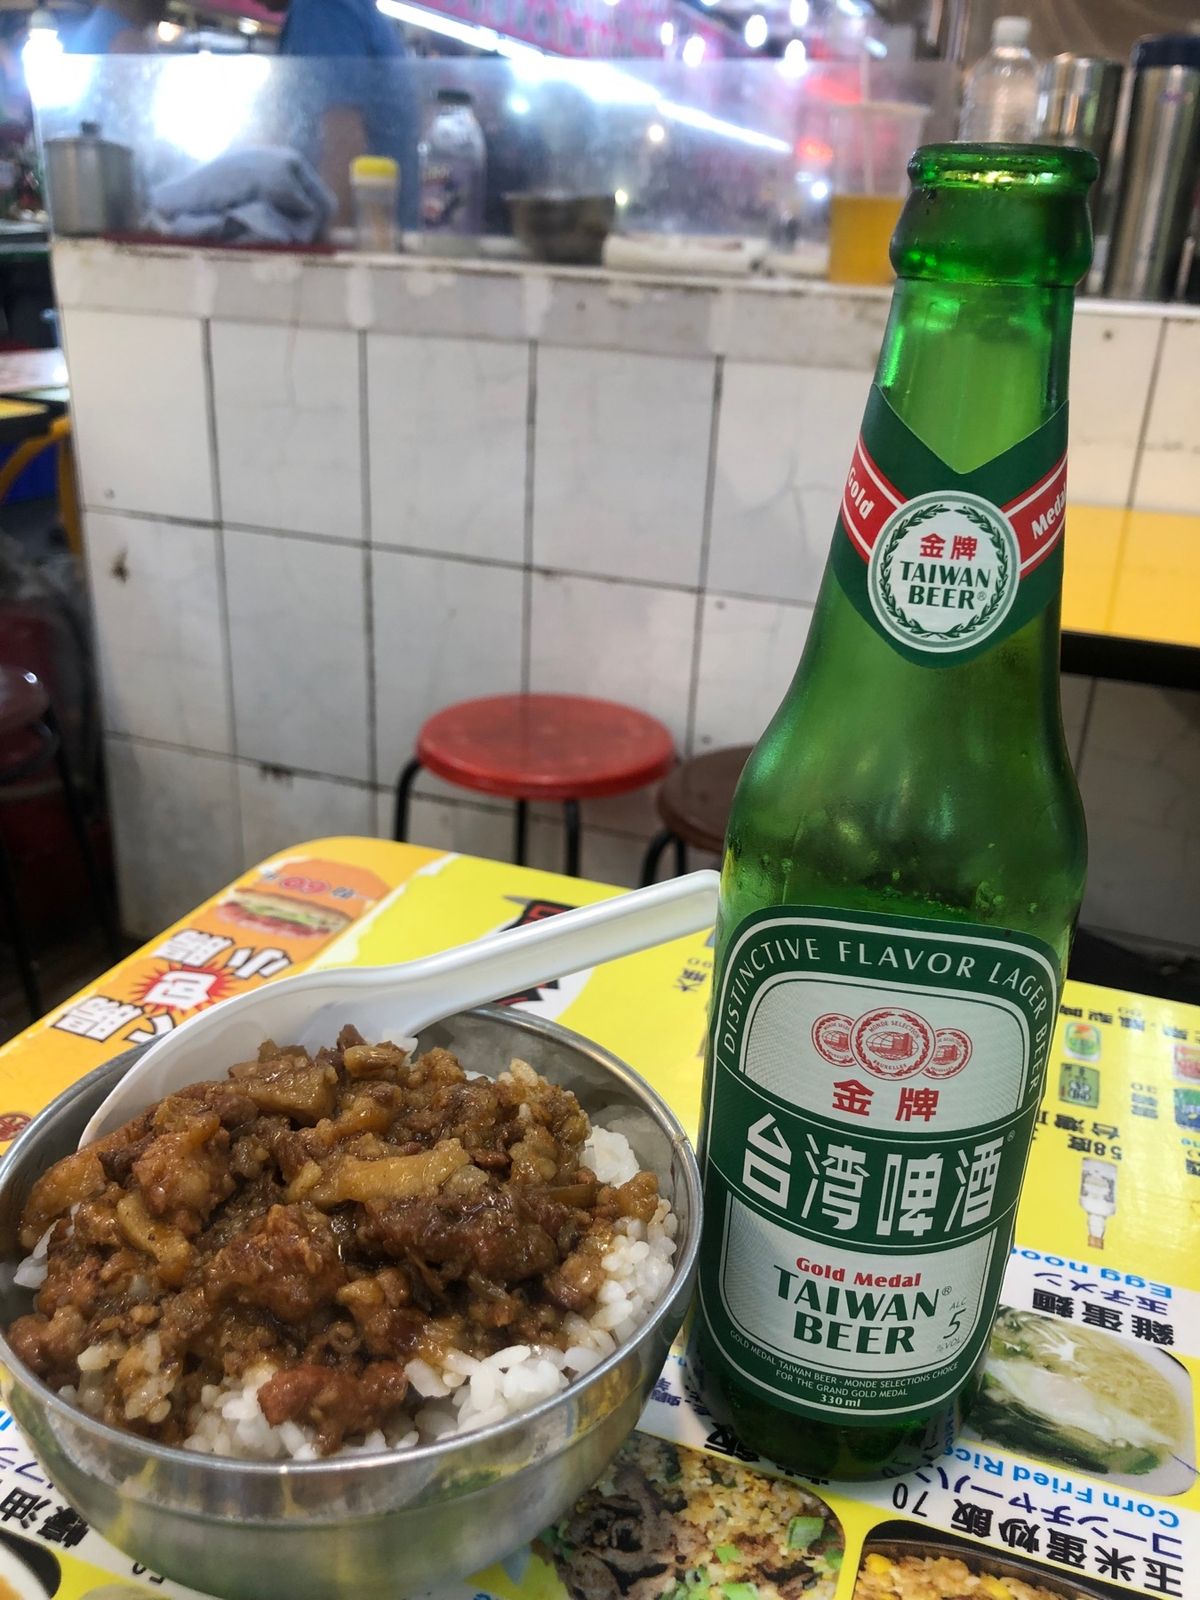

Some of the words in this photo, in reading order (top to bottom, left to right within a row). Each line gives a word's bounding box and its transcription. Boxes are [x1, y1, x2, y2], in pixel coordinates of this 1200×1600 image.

[848, 466, 875, 520] Gold
[919, 533, 978, 562] 金牌
[899, 561, 991, 588] TAIWAN
[908, 584, 976, 610] BEER
[723, 938, 821, 1055] DISTINCTIVE
[838, 940, 977, 980] FLAVOR
[988, 961, 1048, 1021] LAGER
[1028, 1022, 1049, 1094] BEER
[868, 1020, 889, 1033] MONDE
[890, 1020, 921, 1040] SELECTION
[831, 1078, 941, 1123] 金牌
[796, 1256, 846, 1283] Gold
[853, 1271, 922, 1289] Medal
[1010, 1247, 1089, 1275] noo
[773, 1264, 940, 1323] TAIWAN
[1100, 1267, 1173, 1300] Egg
[793, 1310, 916, 1355] BEER
[942, 1307, 967, 1340] 5
[729, 1329, 750, 1347] GOLD
[750, 1344, 776, 1366] MEDAL
[778, 1360, 812, 1379] TAIWAN
[814, 1372, 837, 1385] BEER
[844, 1378, 877, 1389] MONDE
[880, 1373, 931, 1389] SELECTIONS
[931, 1360, 959, 1379] CHOICE
[775, 1369, 793, 1383] FOR
[796, 1376, 814, 1389] THE
[816, 1382, 849, 1397] GRAND
[850, 1388, 877, 1399] GOLD
[879, 1387, 908, 1398] MEDAL
[820, 1393, 843, 1407] 330
[844, 1397, 861, 1408] ml
[892, 1482, 929, 1518] 70
[1012, 1464, 1093, 1505] Fried
[1103, 1491, 1180, 1529] Corn
[950, 1498, 1184, 1598] 玉米蛋炒飯
